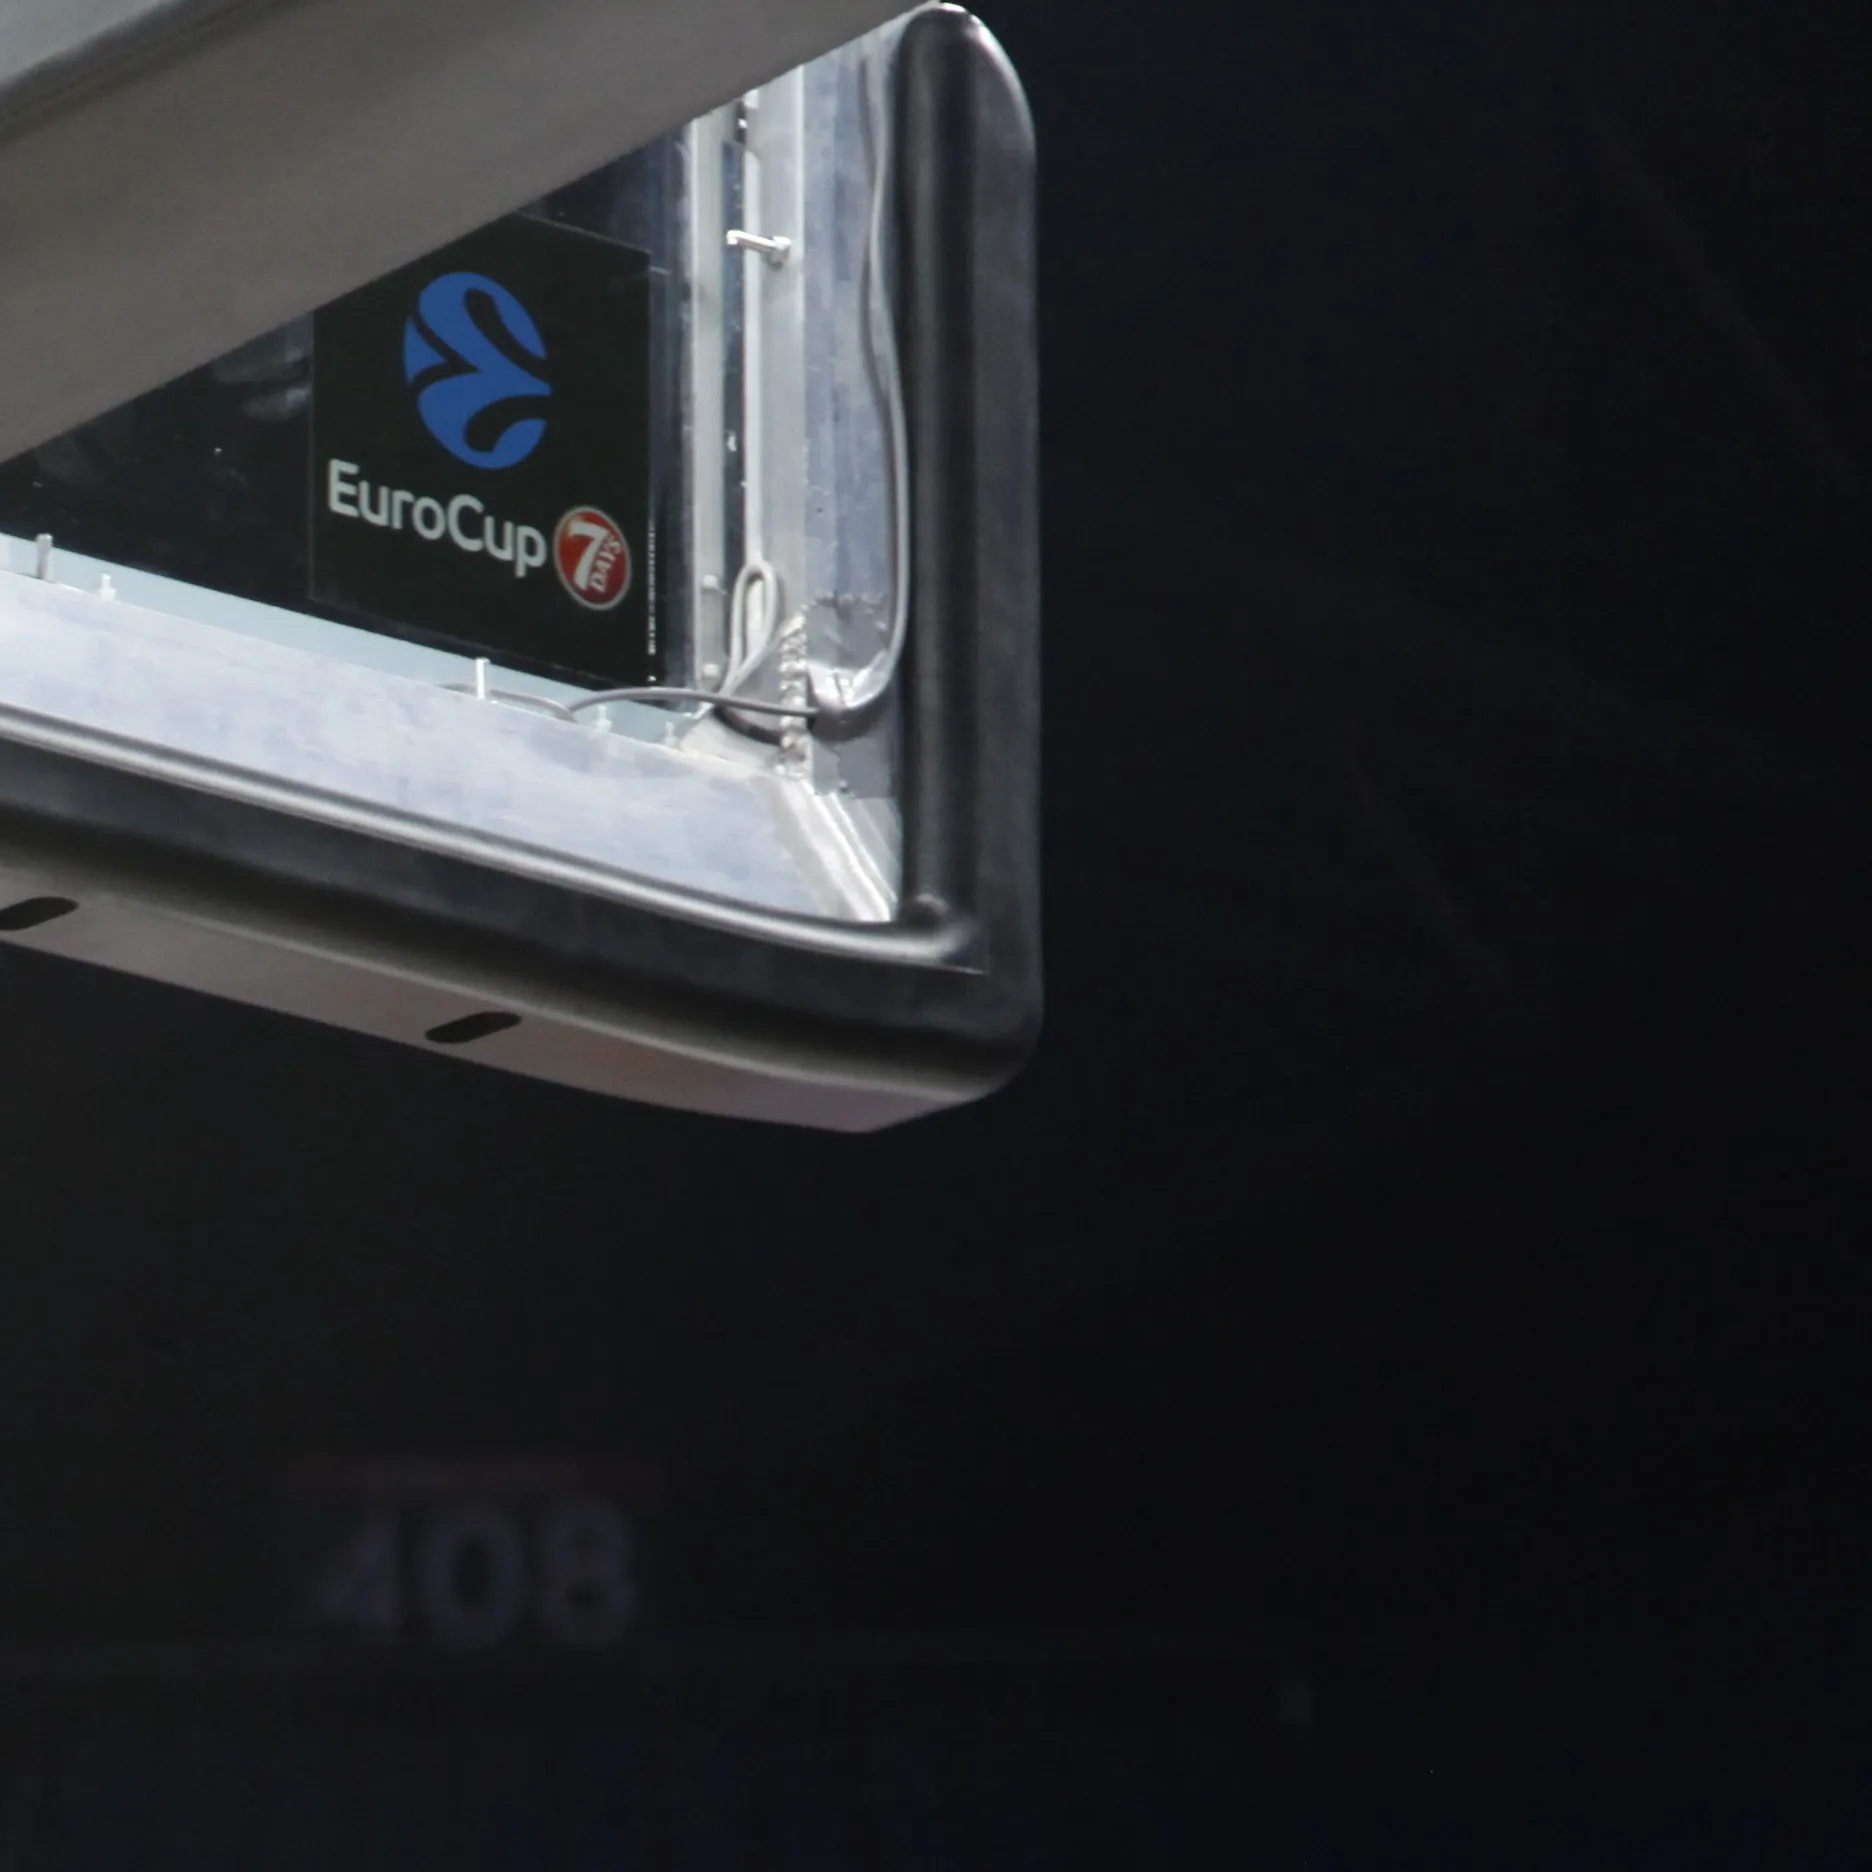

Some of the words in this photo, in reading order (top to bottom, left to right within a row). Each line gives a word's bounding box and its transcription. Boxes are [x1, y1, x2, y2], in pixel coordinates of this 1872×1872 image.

[327, 458, 548, 578] EuroCup
[570, 518, 610, 591] 7
[589, 534, 622, 593] DAYS
[310, 1502, 642, 1652] 408
